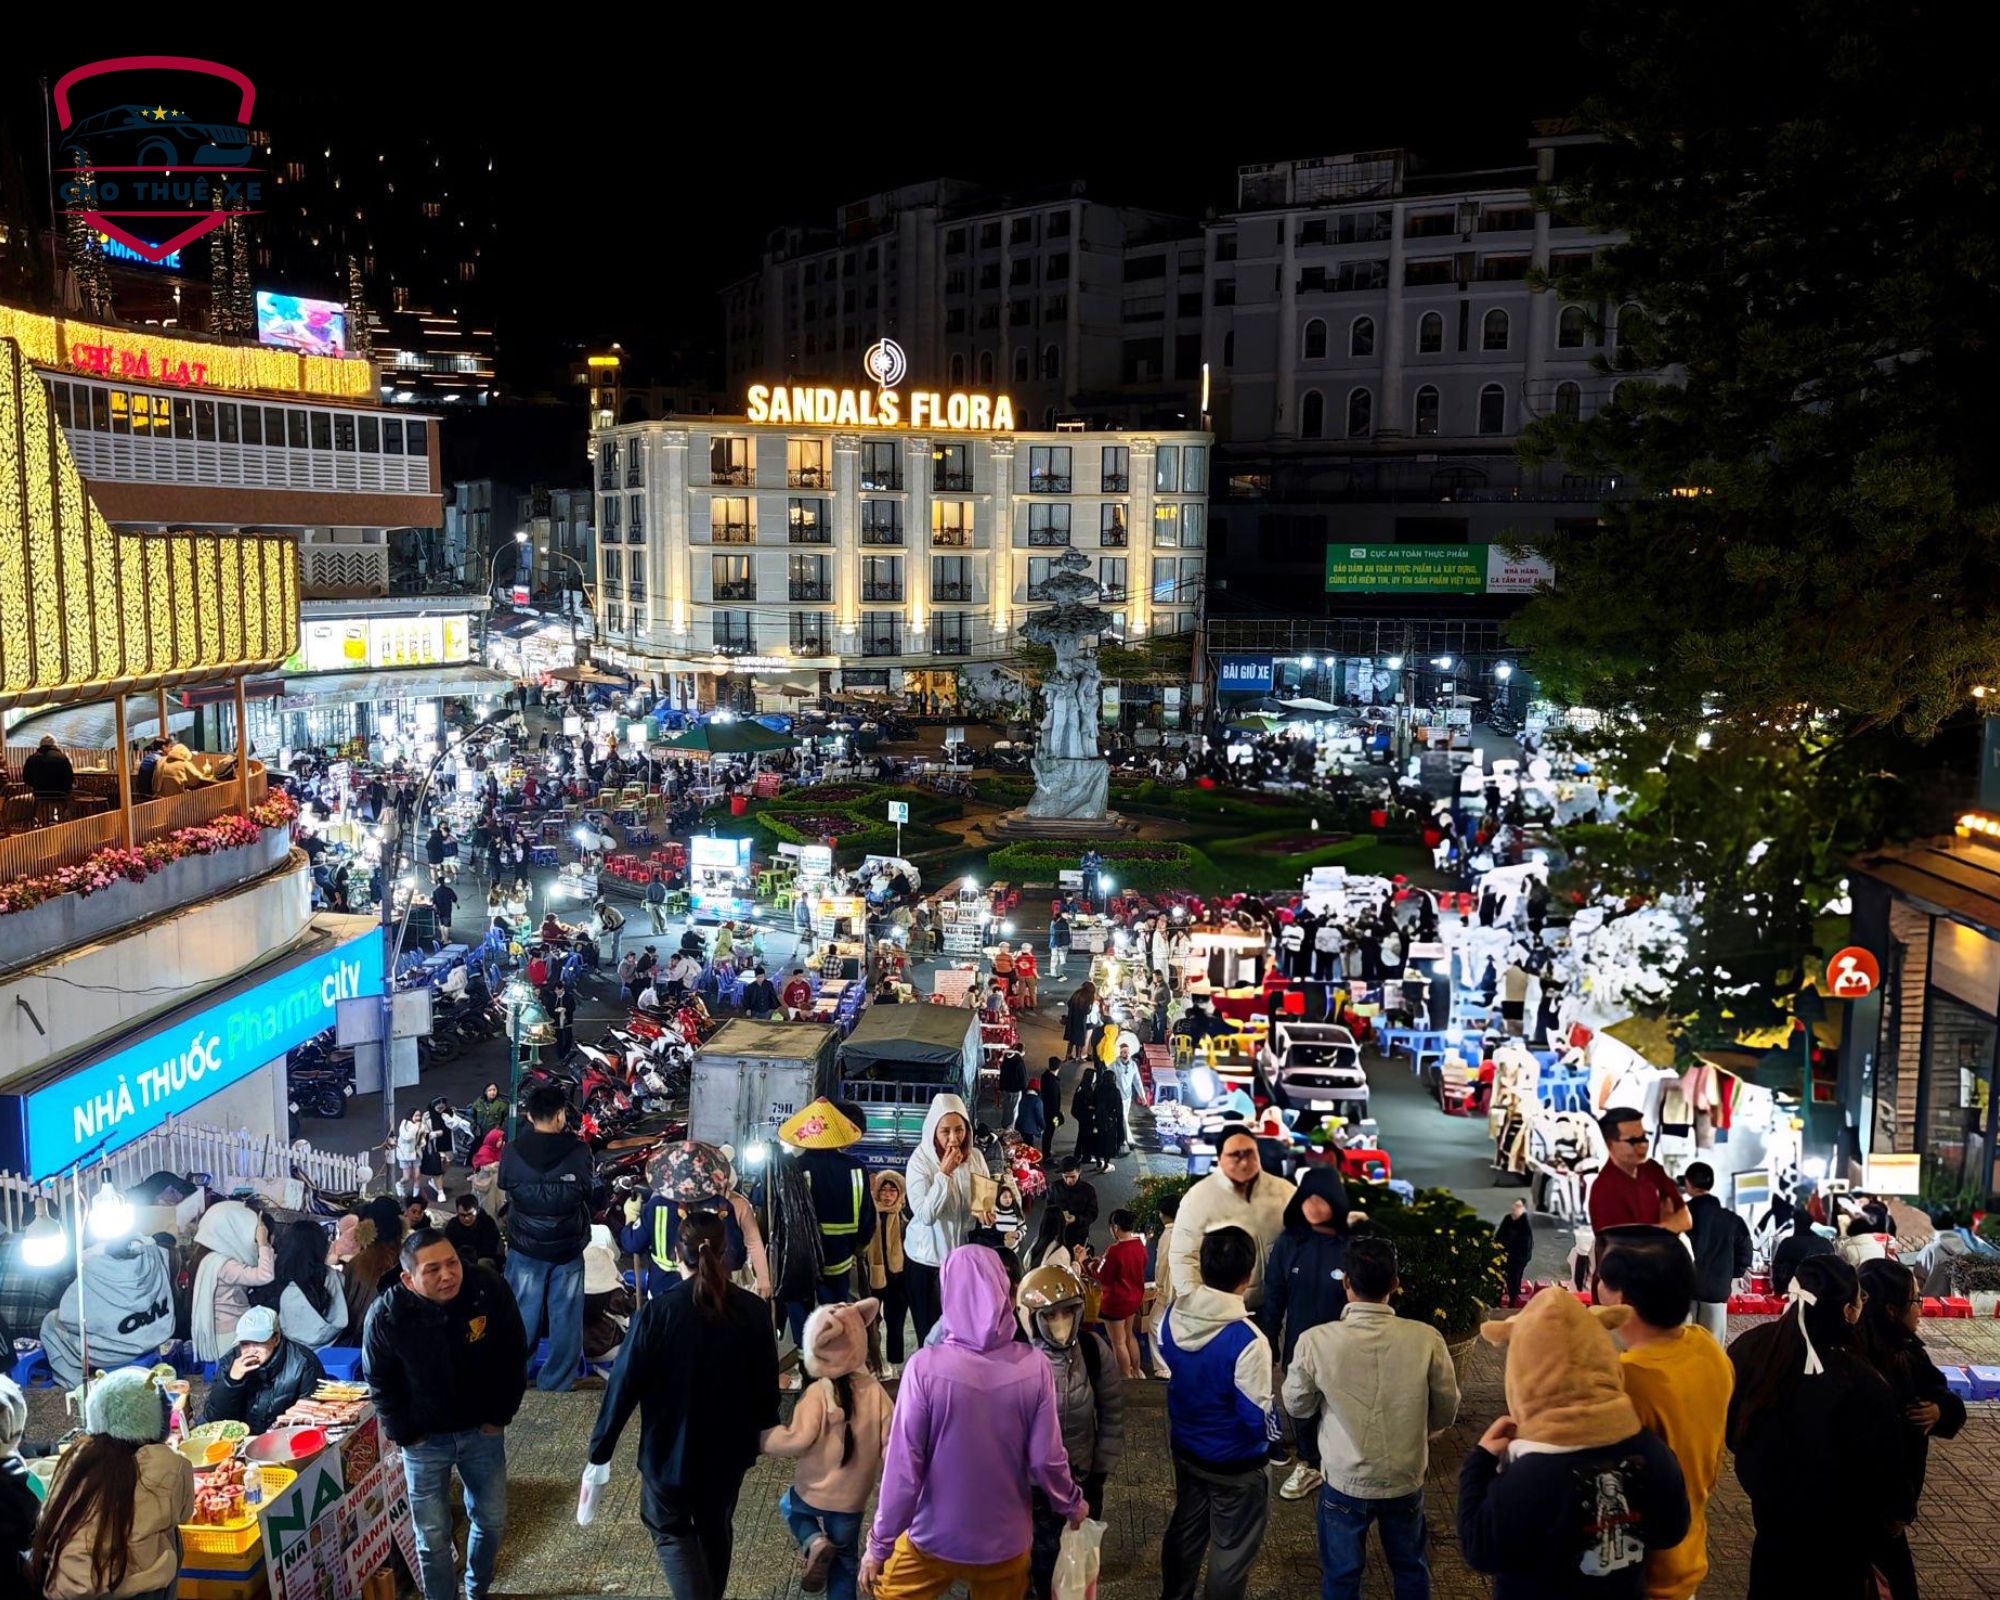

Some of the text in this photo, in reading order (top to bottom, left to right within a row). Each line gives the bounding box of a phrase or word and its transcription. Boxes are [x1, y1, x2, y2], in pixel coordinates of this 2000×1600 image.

[747, 385, 1015, 430] SANDALS FLORA
[1370, 550, 1387, 559] CỤC
[1401, 549, 1422, 558] TOÀN
[1240, 662, 1257, 679] GIỮ
[1258, 665, 1270, 679] XE
[73, 959, 361, 1143] NHÀ THUỐC Pharmacity
[868, 1155, 882, 1164] KIA
[267, 1468, 344, 1561] NA
[389, 1498, 408, 1524] NA
[284, 1539, 307, 1569] NA
[356, 1537, 390, 1584] XANH
